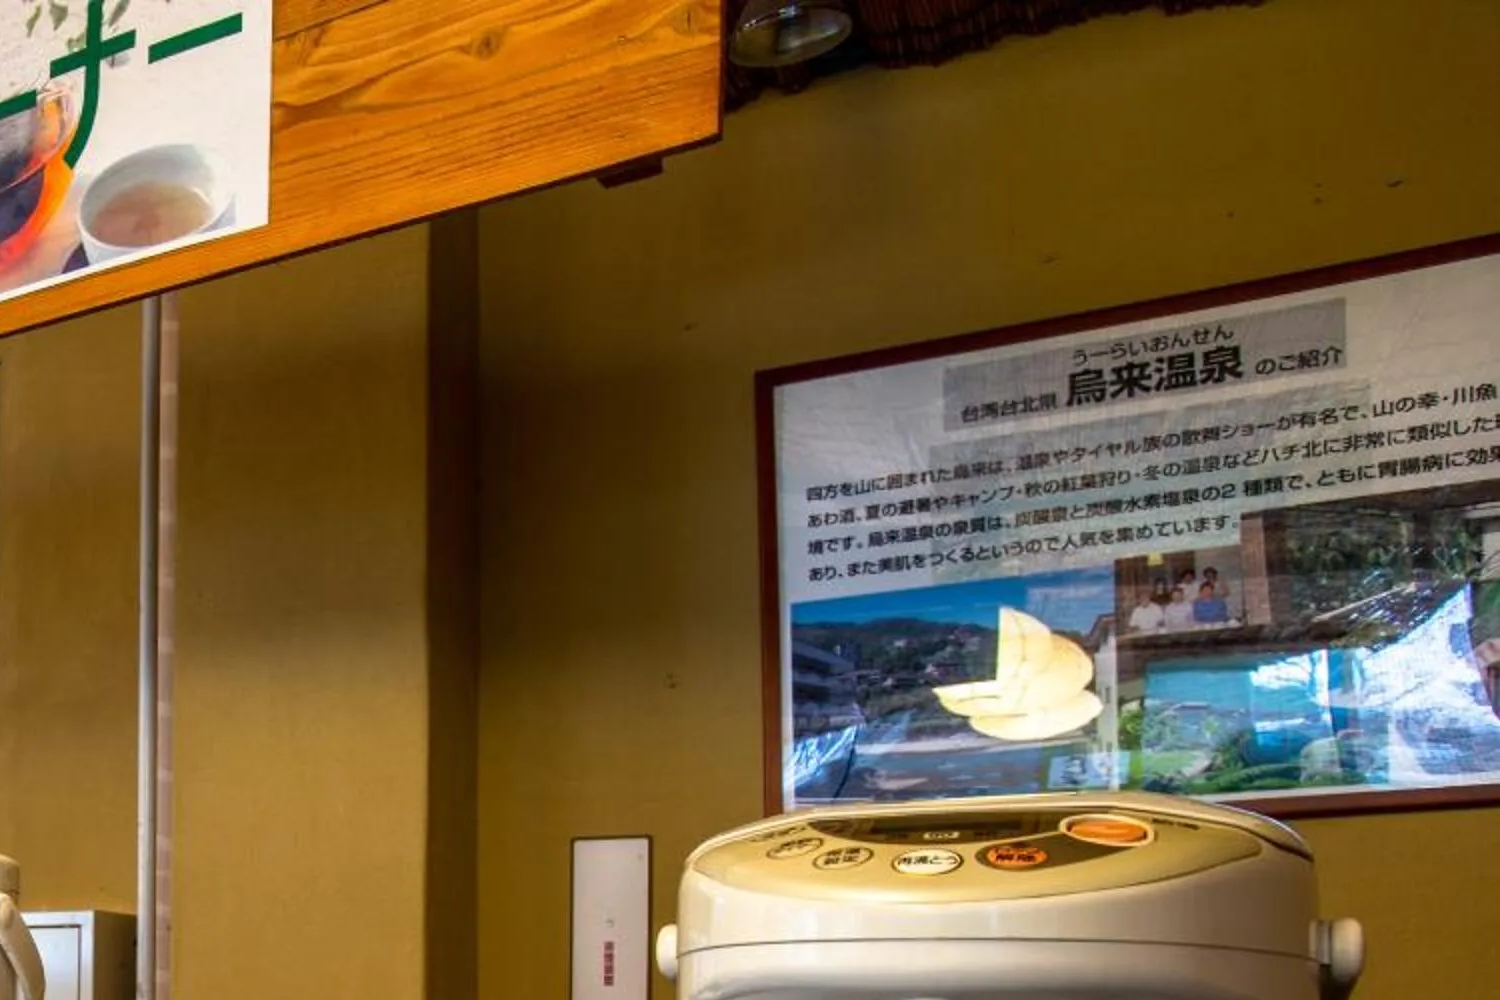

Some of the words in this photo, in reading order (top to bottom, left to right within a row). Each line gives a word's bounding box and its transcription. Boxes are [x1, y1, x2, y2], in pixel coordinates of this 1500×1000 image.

[1073, 325, 1234, 365] うーらいおんせん
[1255, 346, 1344, 376] のご紹介
